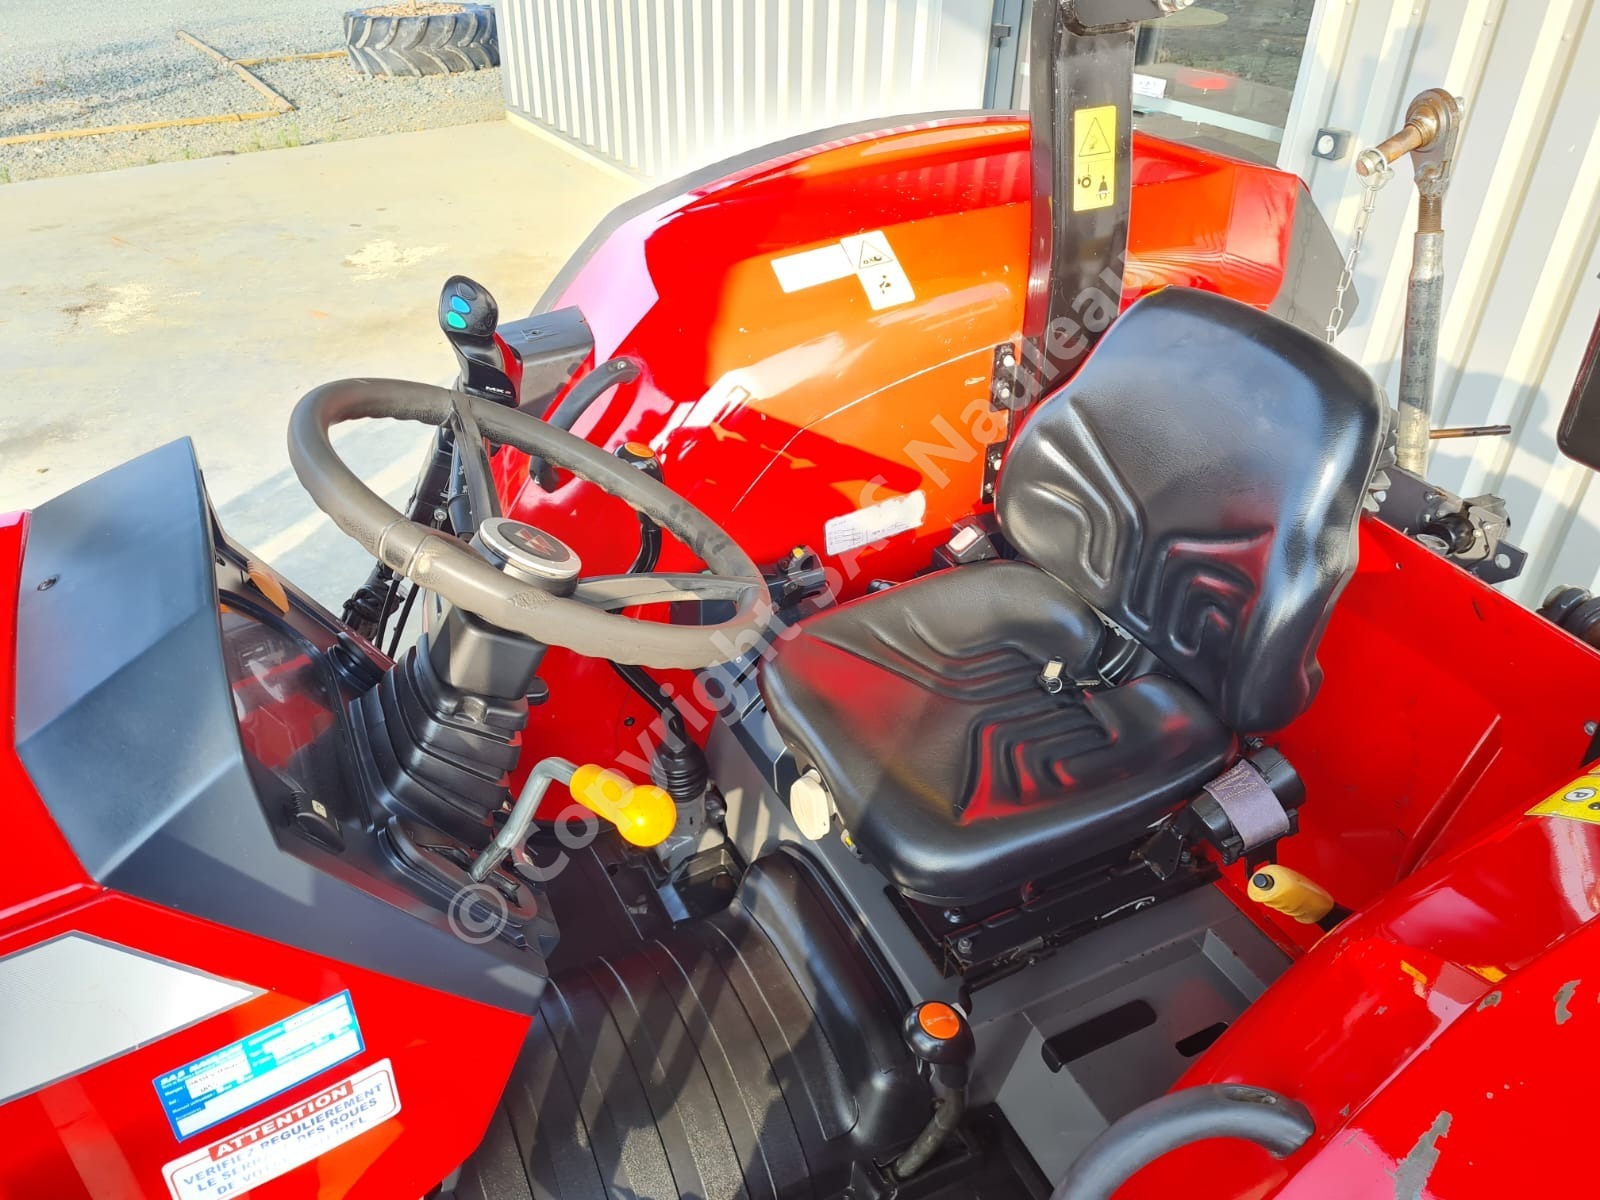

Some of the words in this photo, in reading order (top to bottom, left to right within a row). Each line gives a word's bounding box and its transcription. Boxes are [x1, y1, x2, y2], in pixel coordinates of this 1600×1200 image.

[216, 1084, 349, 1158] ATTENTION
[260, 1083, 383, 1149] REGULIEREMENT
[329, 1097, 378, 1128] ROUES
